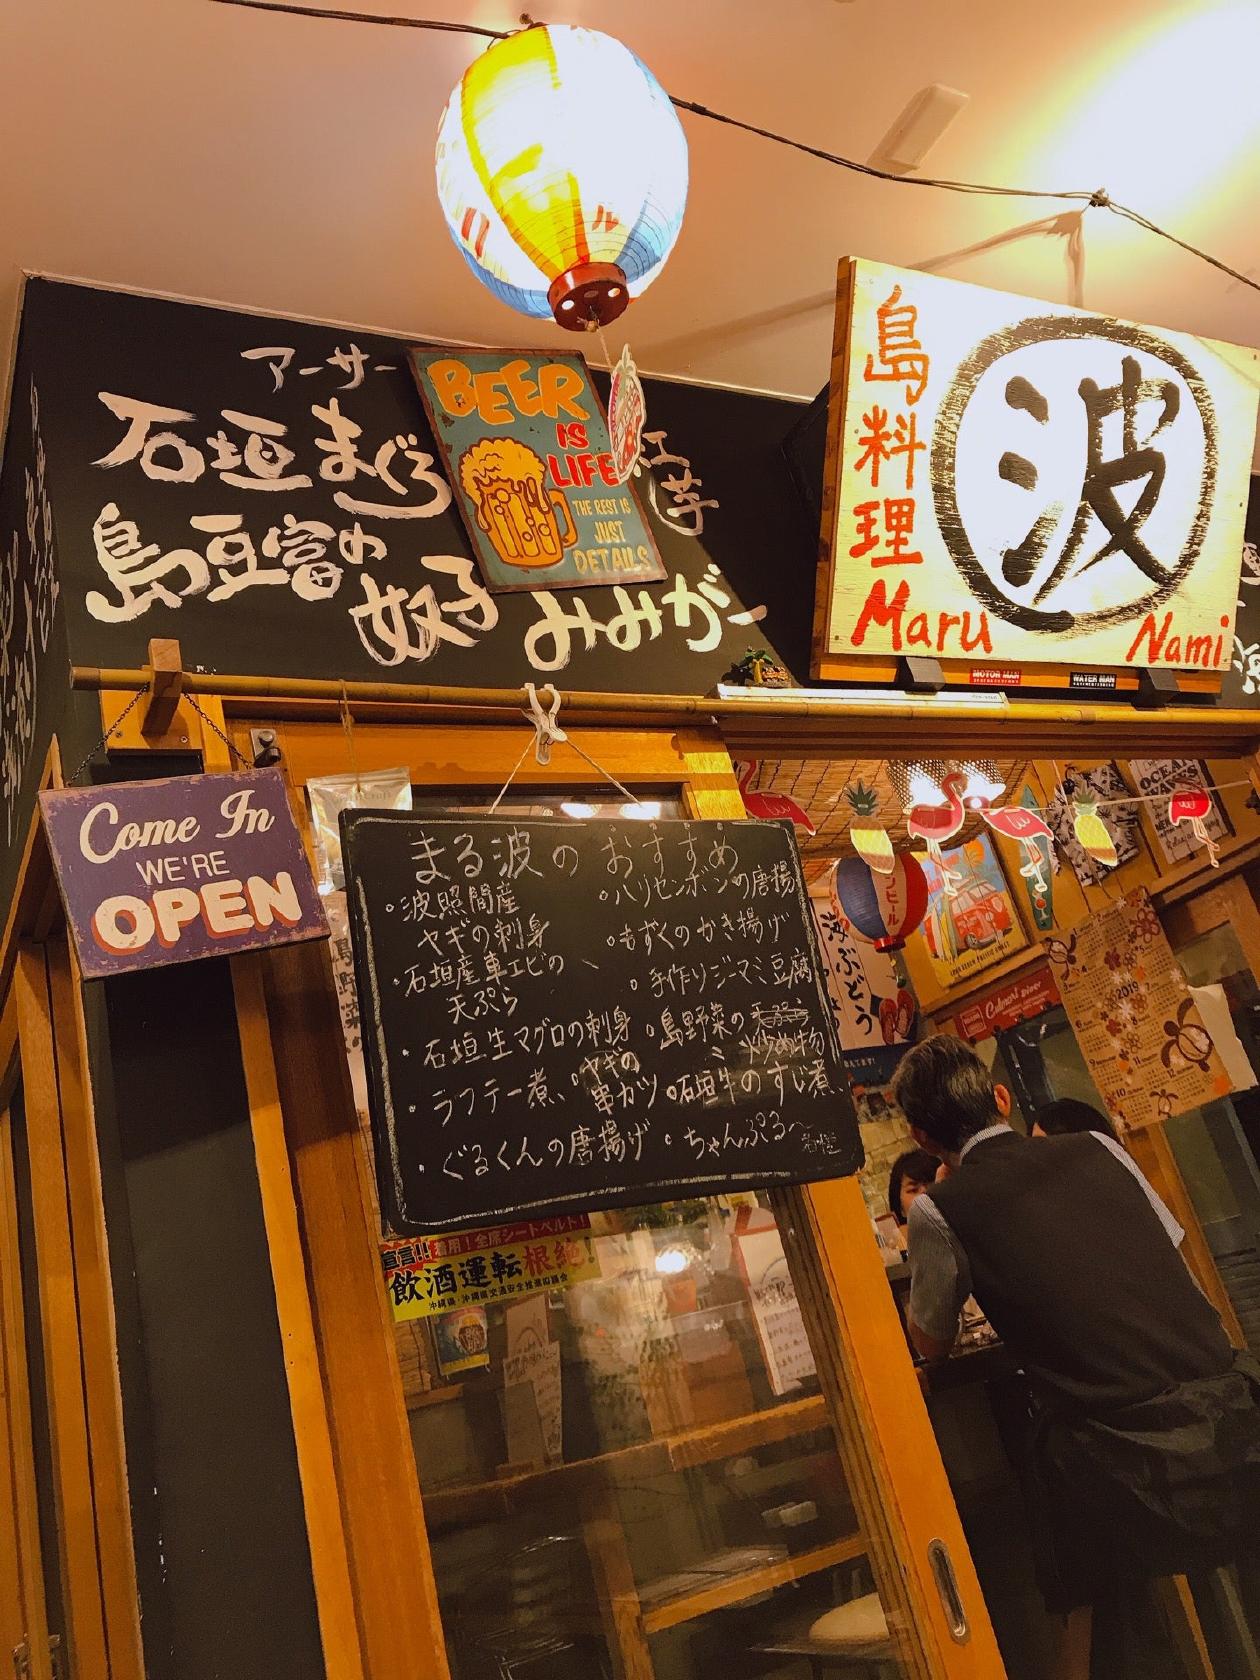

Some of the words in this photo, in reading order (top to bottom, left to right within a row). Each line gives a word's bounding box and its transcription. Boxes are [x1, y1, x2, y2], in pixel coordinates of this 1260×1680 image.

[240, 342, 398, 393] アーサー
[427, 358, 591, 425] BEER
[555, 421, 590, 449] IS
[849, 284, 930, 569] 島料理
[89, 390, 451, 519] 石垣まぐろ
[548, 452, 620, 488] LIFE
[998, 354, 1180, 606] 波
[572, 499, 593, 517] THE
[594, 498, 618, 516] REST
[620, 497, 632, 514] IS
[594, 519, 626, 544] JUST
[573, 546, 652, 576] DETAILS
[524, 562, 768, 672] みみがー
[850, 578, 993, 654] Maru
[1125, 612, 1230, 668] Nami
[79, 802, 201, 864] Come
[215, 789, 276, 839] In
[136, 850, 231, 886] WE'RE
[90, 871, 303, 956] OPEN
[402, 881, 521, 922] 波照間産
[447, 986, 519, 1025] 天ぷら
[1116, 981, 1139, 1000] 2019
